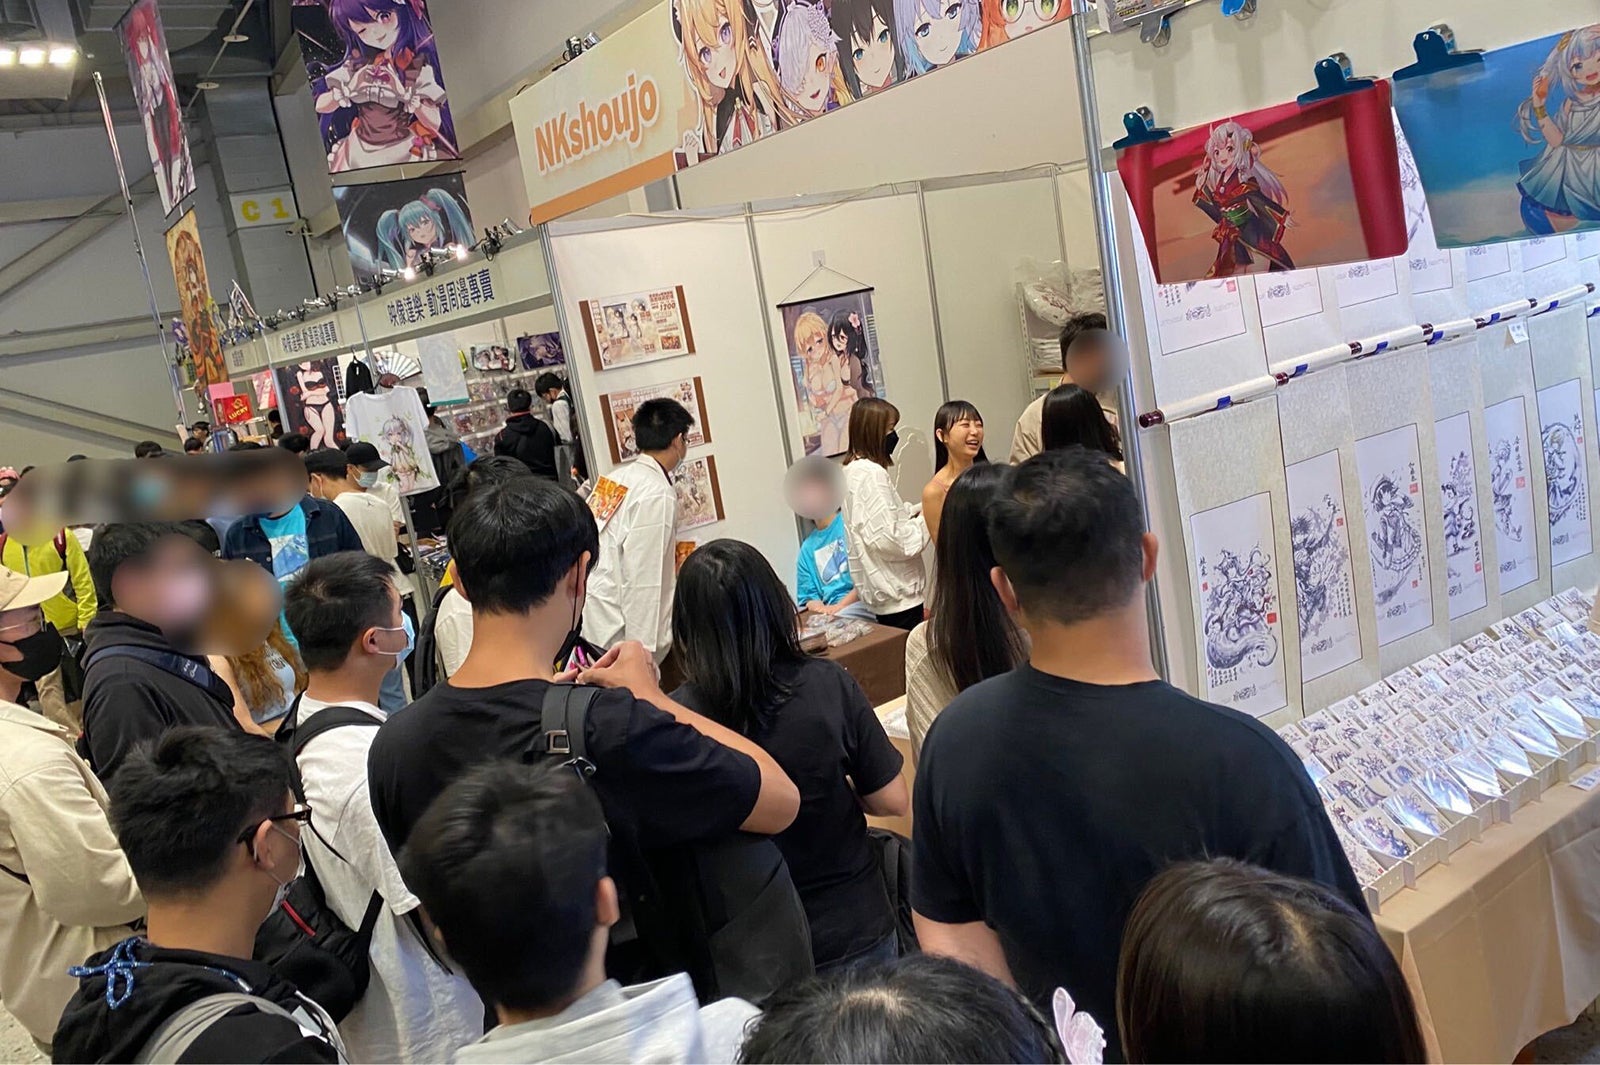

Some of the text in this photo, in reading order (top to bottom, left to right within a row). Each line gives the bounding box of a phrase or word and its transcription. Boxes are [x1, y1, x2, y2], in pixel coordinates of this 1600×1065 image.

[534, 72, 658, 172] NKshoujo
[242, 197, 290, 222] C 1
[228, 406, 248, 420] LUCKY
